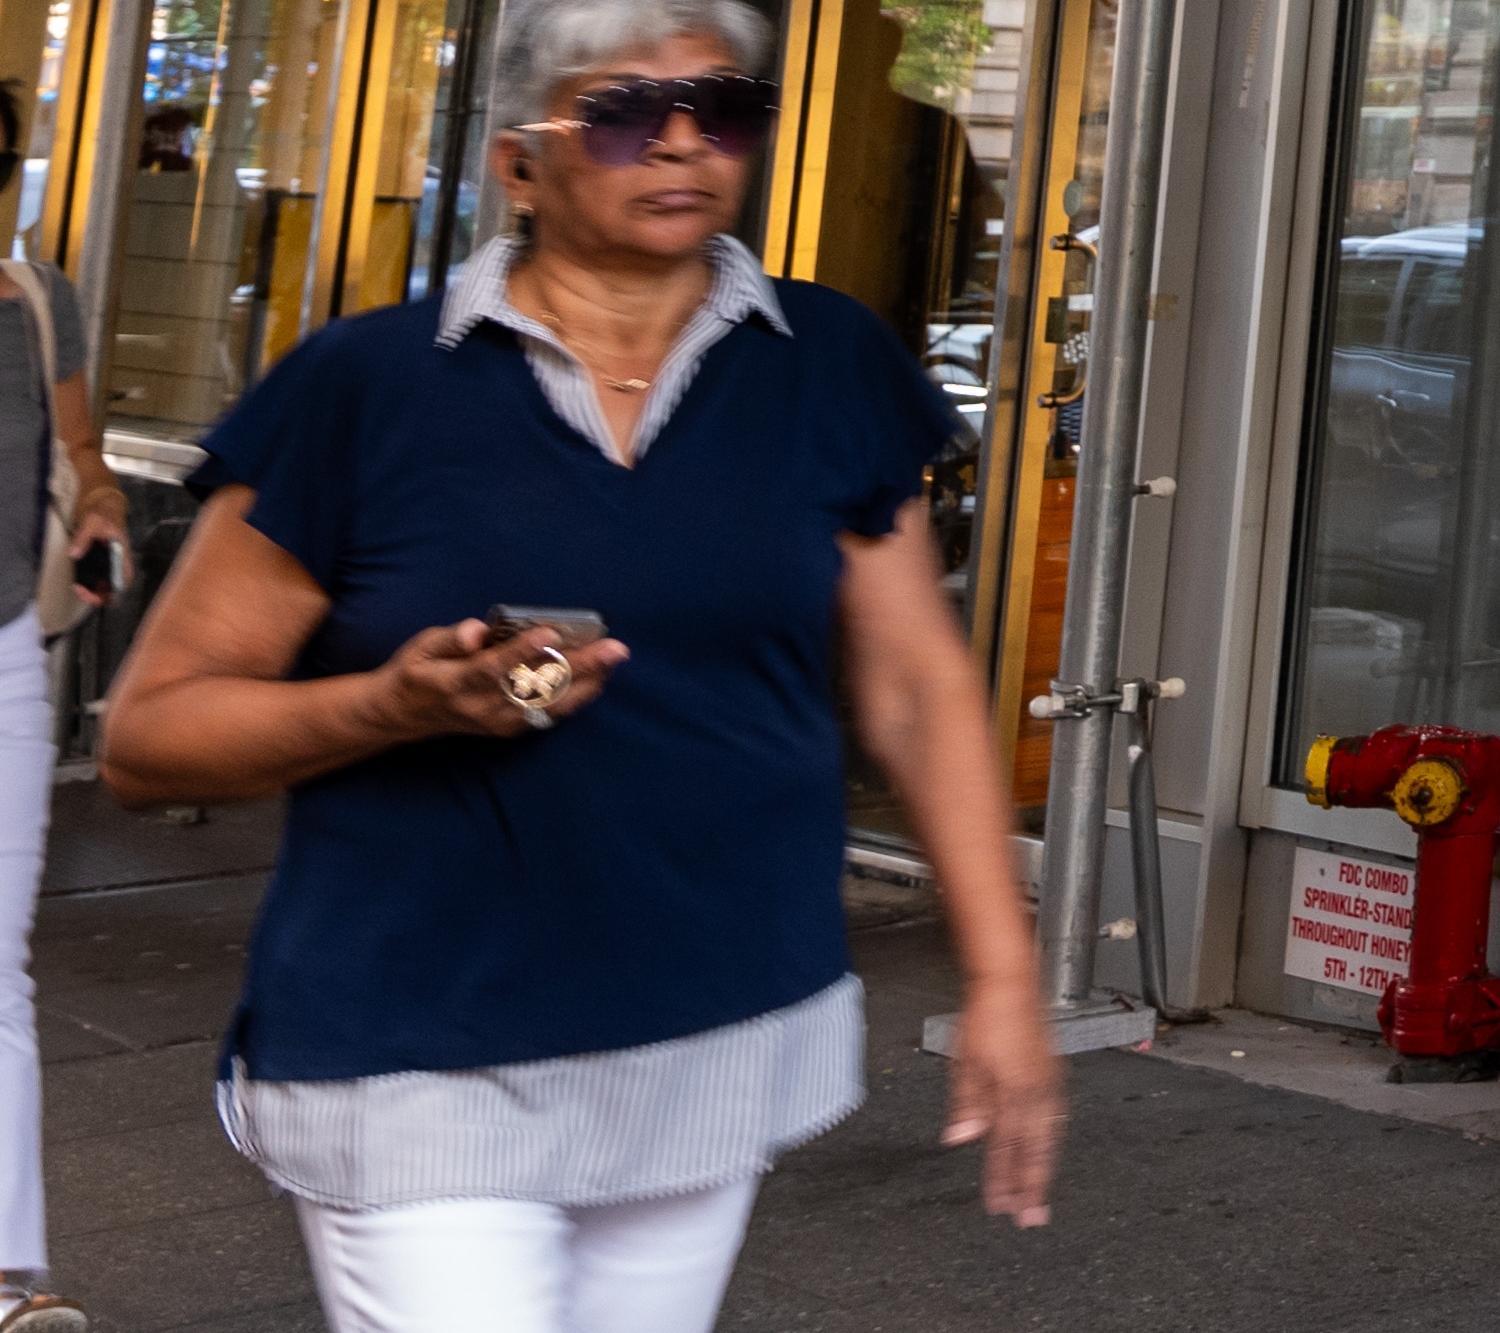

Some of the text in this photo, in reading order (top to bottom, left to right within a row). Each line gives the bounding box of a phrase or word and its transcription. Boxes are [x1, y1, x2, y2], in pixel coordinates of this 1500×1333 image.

[1339, 862, 1409, 896] FDC COMBO
[1292, 916, 1369, 953] THROUGHOUT
[1324, 957, 1347, 981] 5TH
[1360, 965, 1388, 990] 12TH
